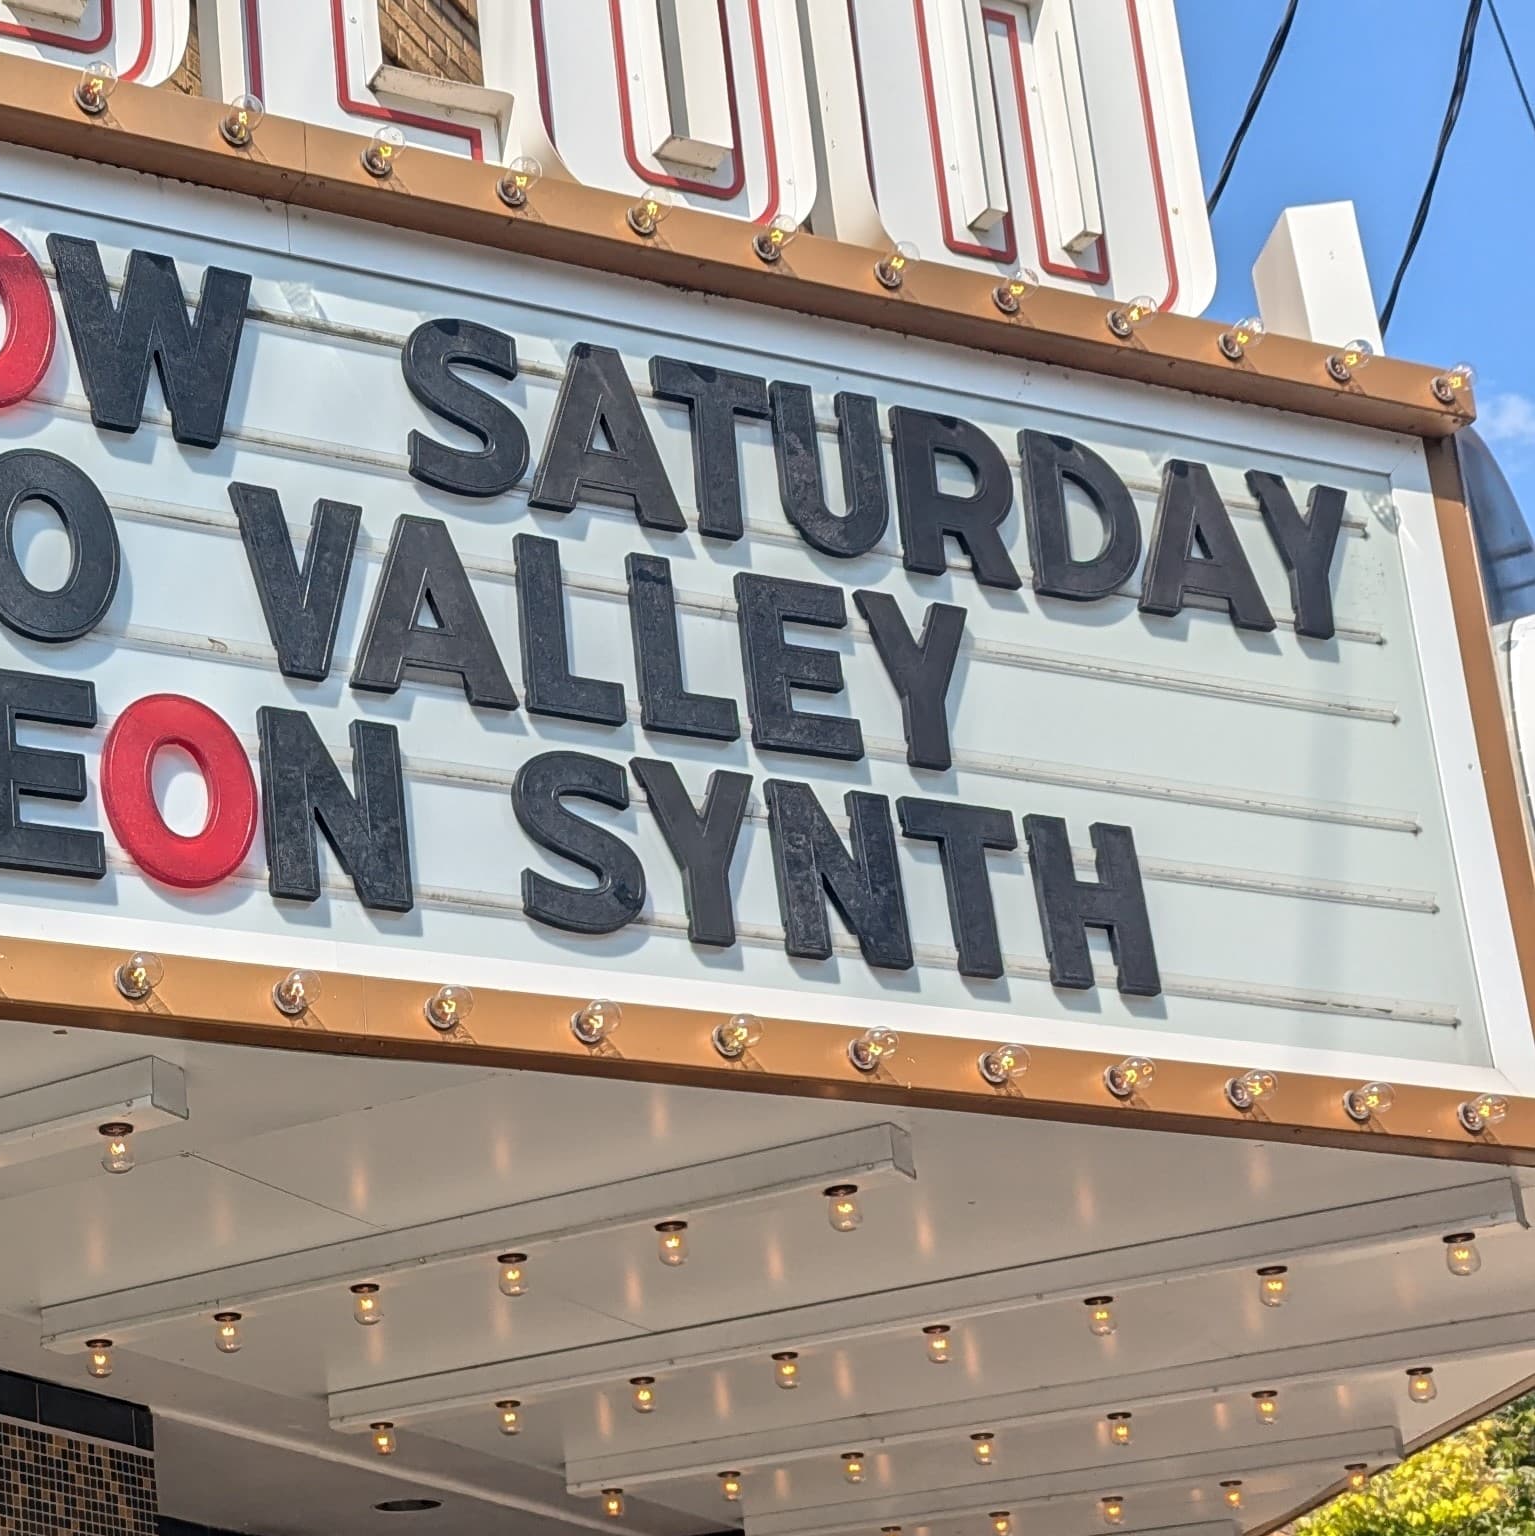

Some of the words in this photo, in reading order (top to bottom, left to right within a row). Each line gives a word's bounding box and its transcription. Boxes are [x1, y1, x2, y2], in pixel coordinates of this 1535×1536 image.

[401, 319, 1346, 643] SATURDAY
[228, 482, 967, 773] VALLEY
[511, 751, 1163, 998] SYNTH
